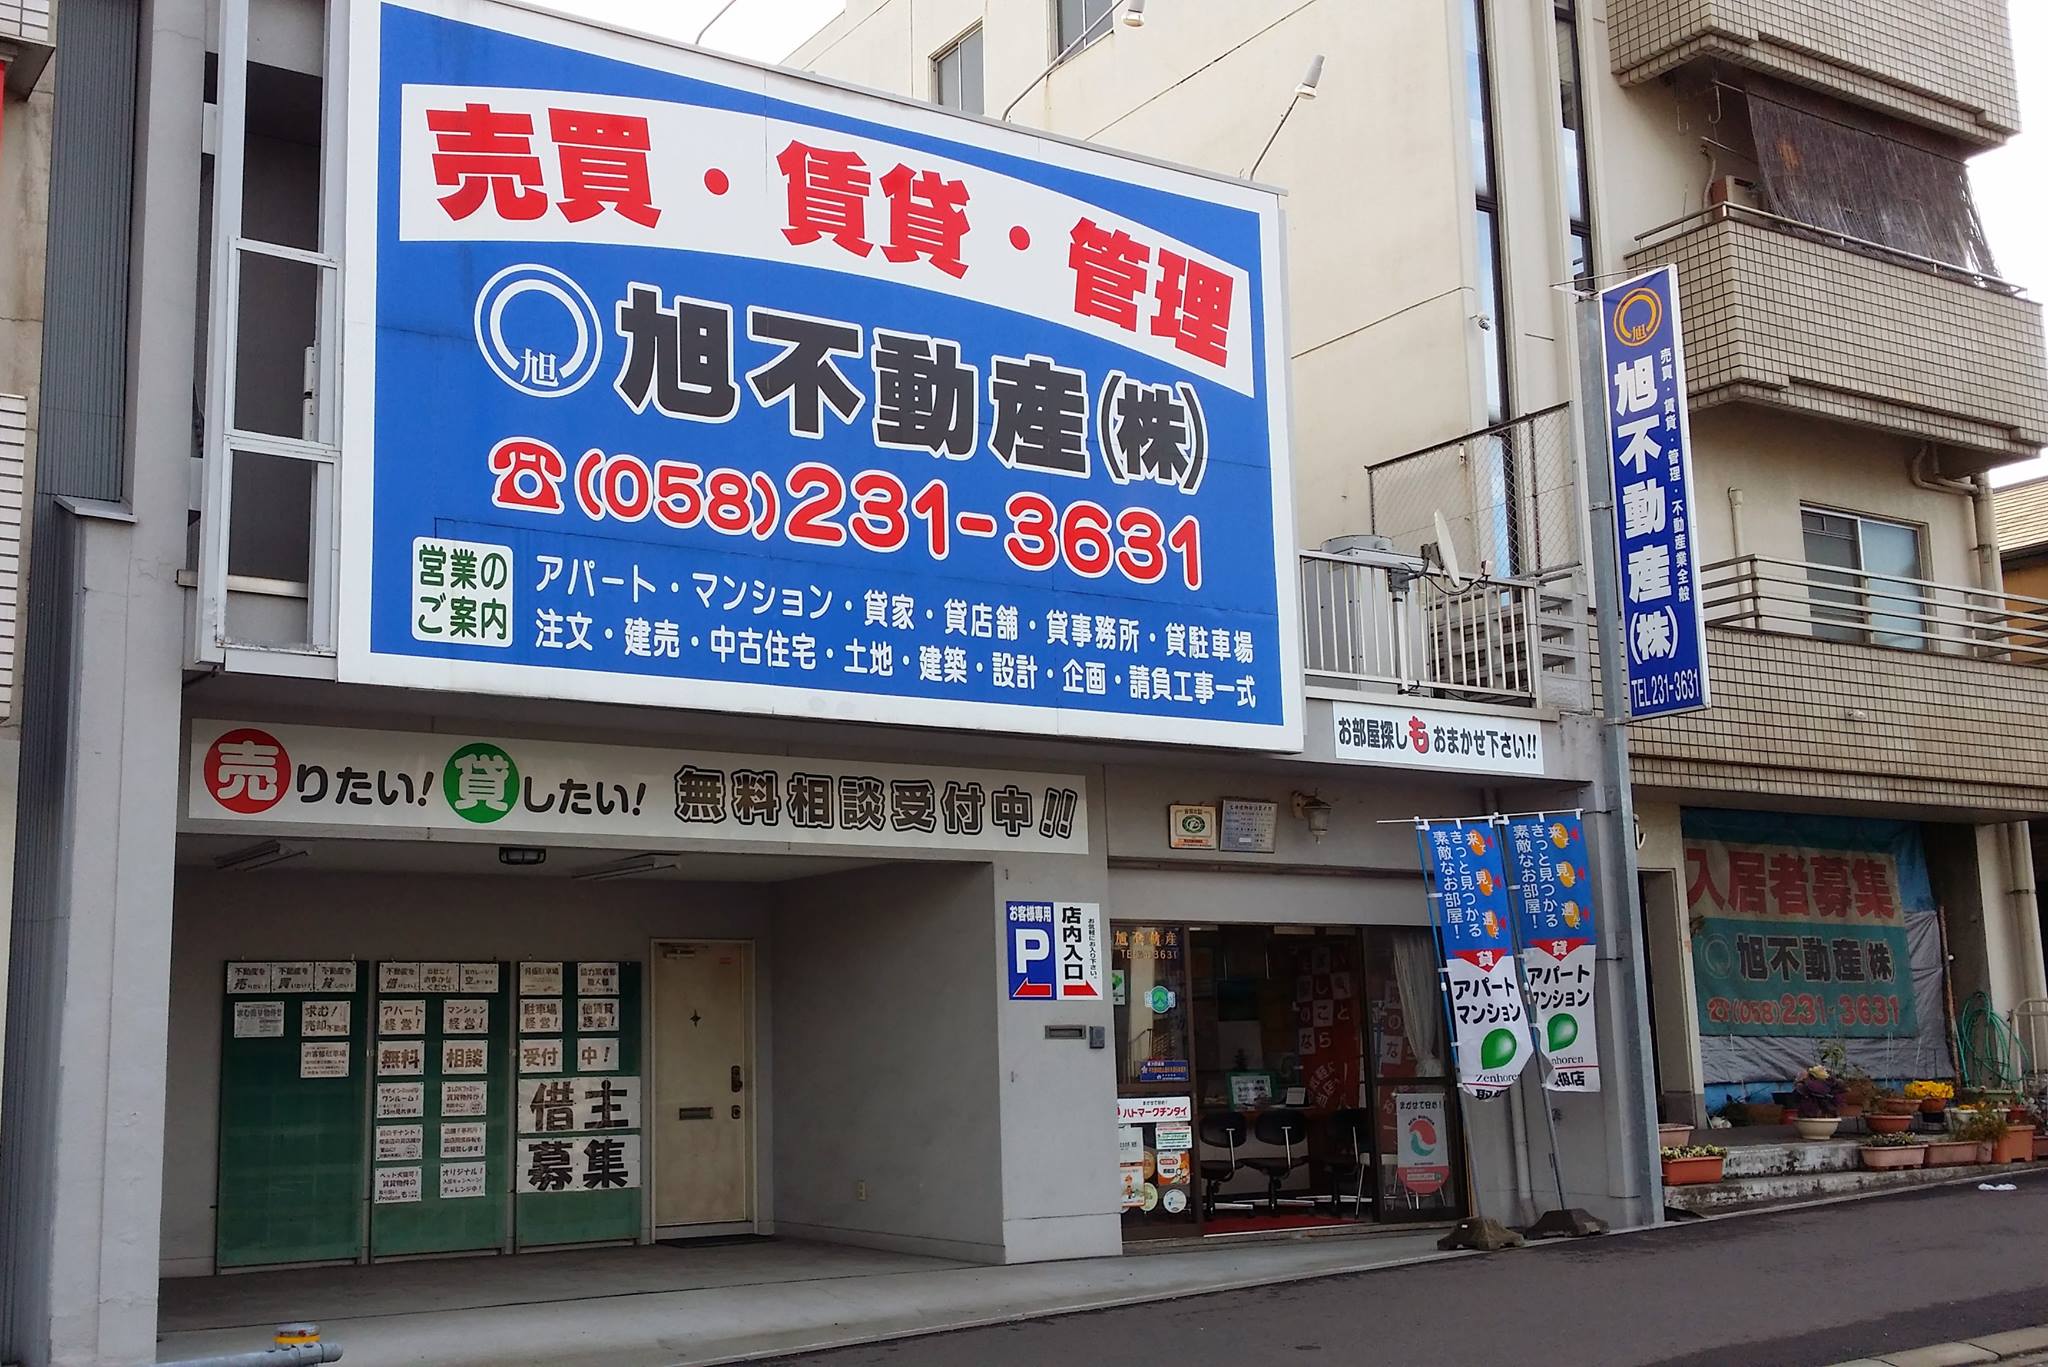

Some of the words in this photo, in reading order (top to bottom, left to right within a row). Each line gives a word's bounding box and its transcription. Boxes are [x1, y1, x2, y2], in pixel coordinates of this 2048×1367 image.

[519, 348, 559, 389] 旭
[617, 283, 1207, 491] 旭不動産(株)
[577, 448, 1203, 590] (058)231-3631
[1614, 355, 1678, 664] 旭不動産(株)
[419, 544, 508, 590] 営業の
[418, 592, 507, 639] ご案内
[1338, 715, 1537, 759] お部屋探しもおまかせ下さい!!
[674, 764, 1078, 839] 無料相談受付中!!
[1433, 831, 1463, 939] 素敵なお部屋!
[1450, 832, 1481, 938] きっと見つかる
[1513, 825, 1541, 929] 素敵なお部屋!
[1531, 825, 1558, 928] きっと見つかる
[1686, 848, 1894, 919] 入居者募集
[1015, 928, 1050, 973] P
[1062, 907, 1083, 980] 店内入口
[1736, 933, 1895, 983] 旭不動産(株)
[1454, 977, 1514, 1000] アパート
[1528, 964, 1590, 985] アパート
[1457, 1003, 1520, 1024] マンション
[382, 1049, 419, 1068] 無料
[446, 1049, 483, 1068] 相談
[524, 1048, 558, 1066] 受付
[530, 1080, 629, 1131] 借主
[1123, 1107, 1187, 1118] ハトマークチンタイ
[528, 1139, 628, 1191] 募集
